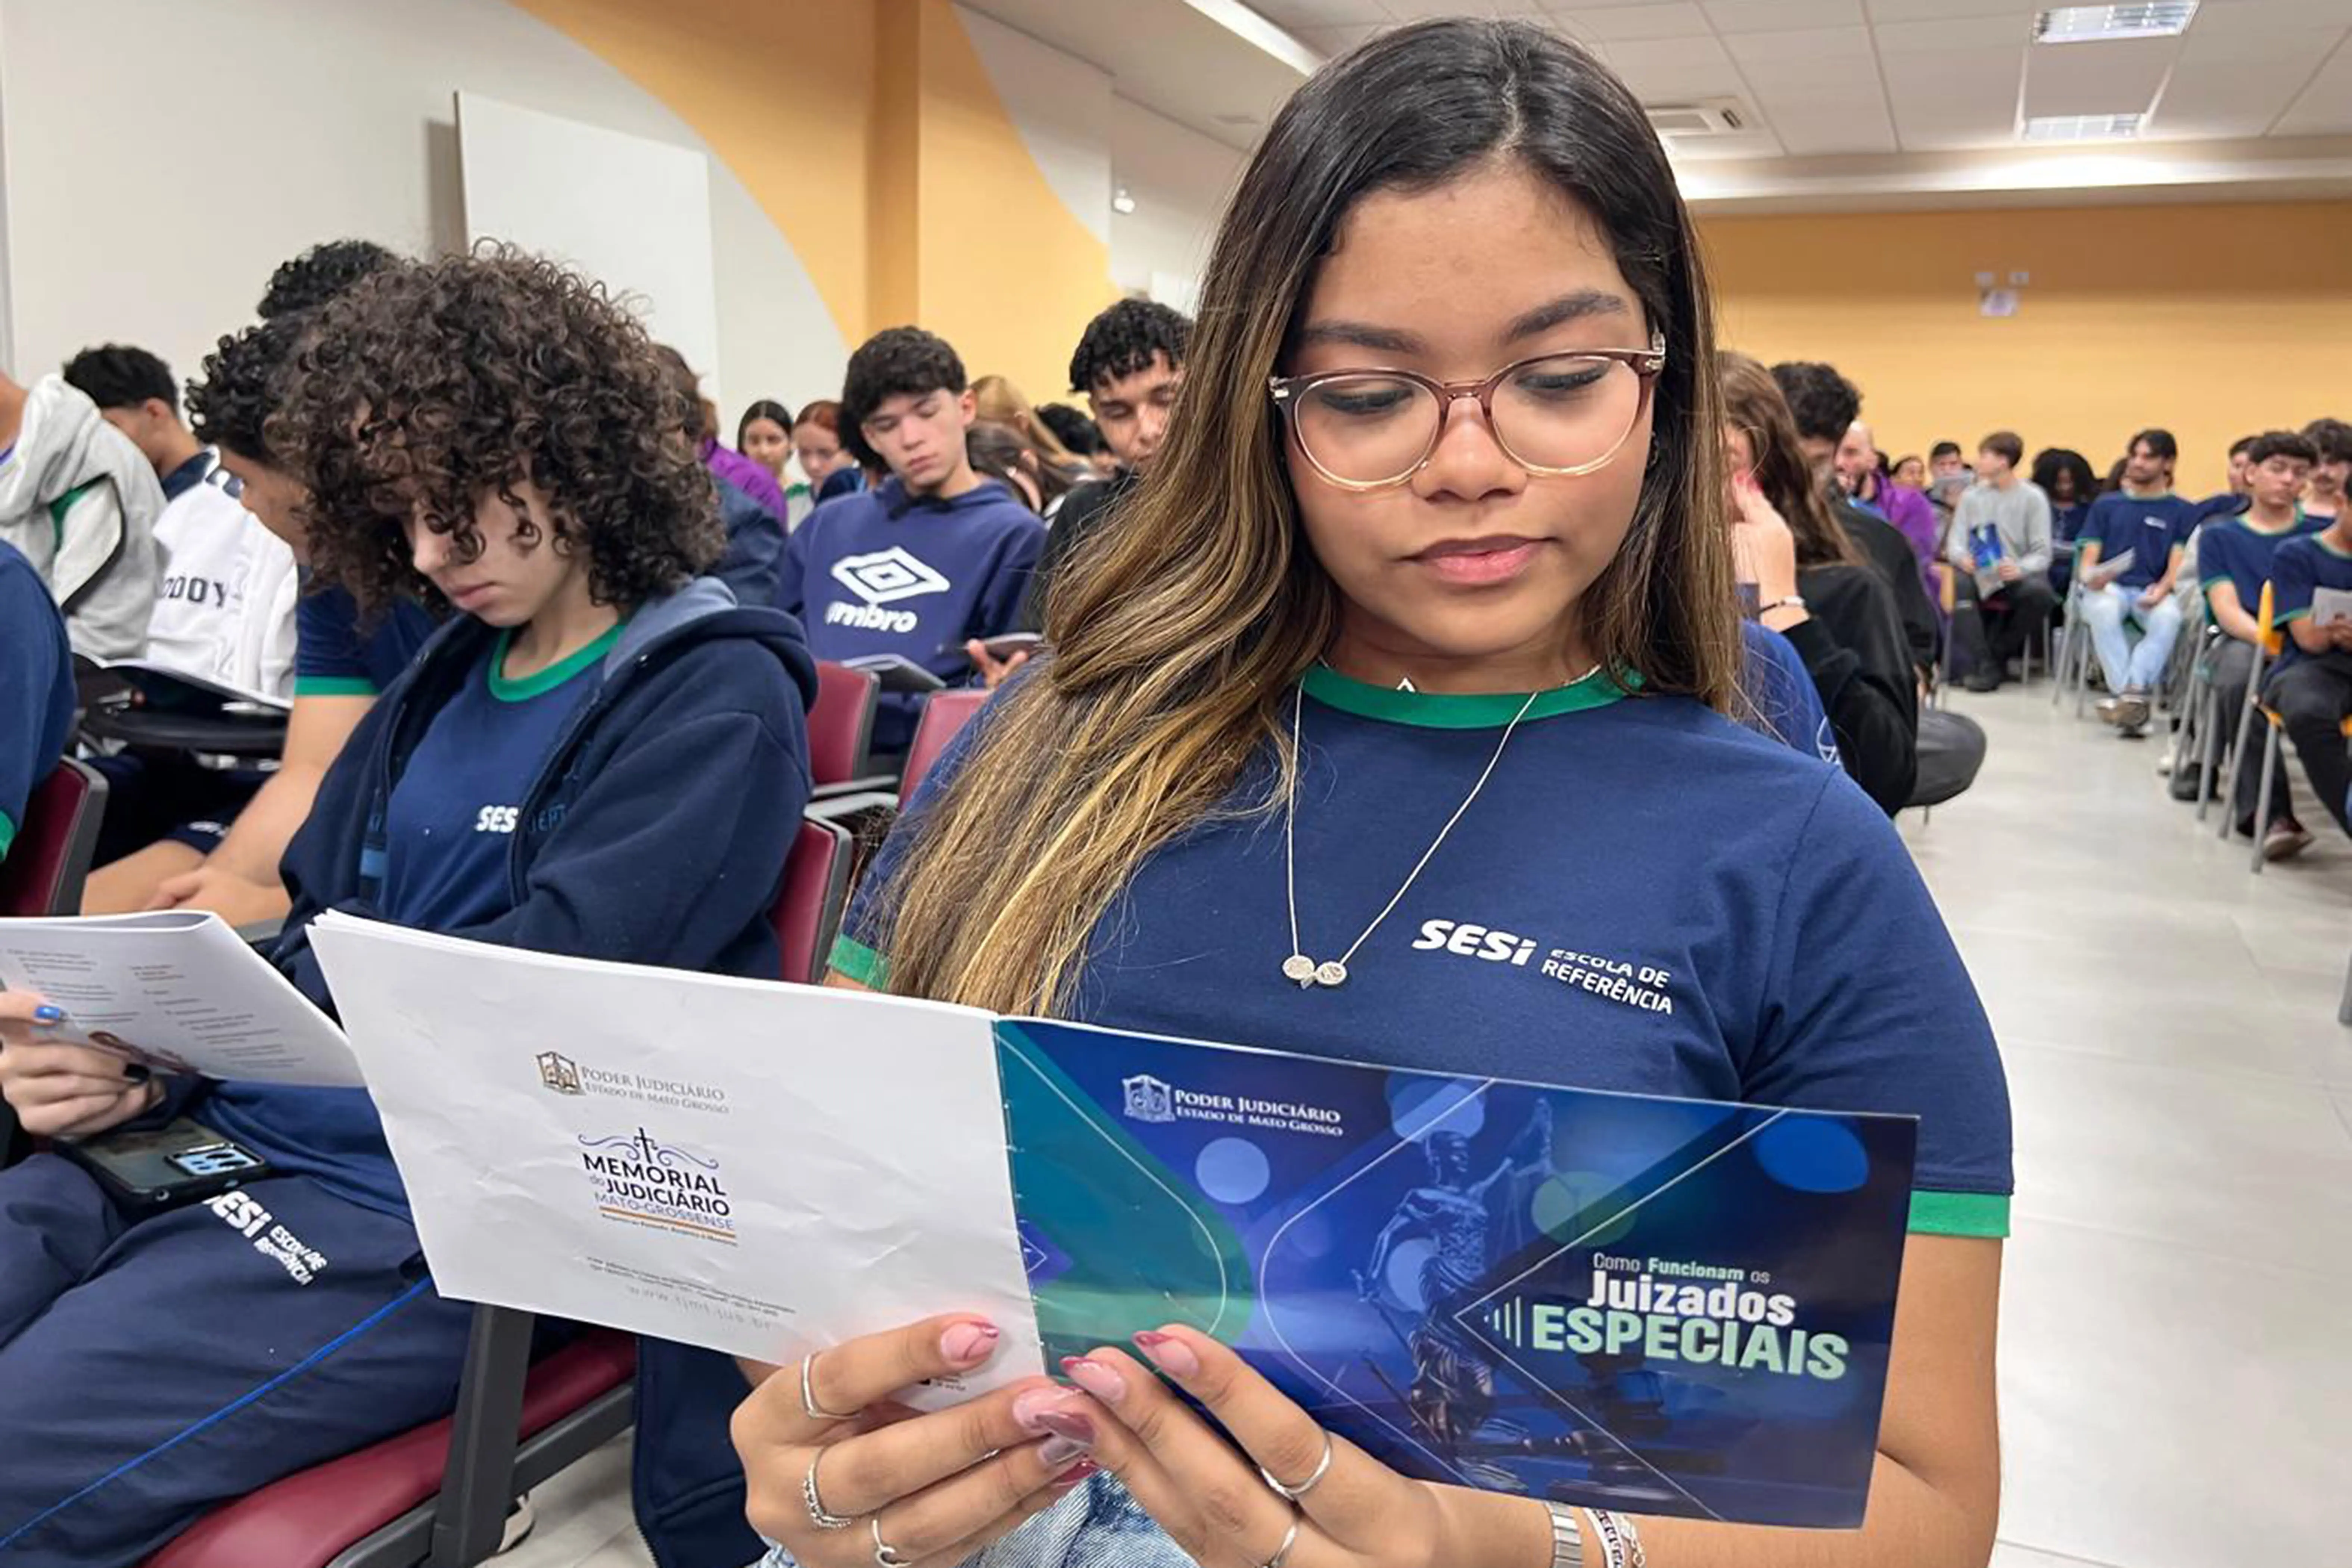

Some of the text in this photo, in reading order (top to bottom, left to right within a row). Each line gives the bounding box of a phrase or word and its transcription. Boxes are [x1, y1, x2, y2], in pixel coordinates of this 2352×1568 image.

[1541, 959, 1673, 1015] REFERÊNCIA
[1549, 949, 1671, 988] ESCOLA DE
[581, 1066, 725, 1101] PODER JUDICIÁRIO
[1175, 1089, 1341, 1123] PODER JUDICIÁRIO
[1177, 1106, 1343, 1137] ESTADO DE MATO GROSSO
[583, 1153, 727, 1196] MEMORIAL
[595, 1192, 734, 1230] MATO-GROSSENSE
[607, 1178, 730, 1216] JUDICIÁRIO
[1593, 1252, 1770, 1285] Como Funcionam os
[1587, 1270, 1796, 1327] Juizados
[1531, 1304, 1850, 1381] ESPECIAIS
